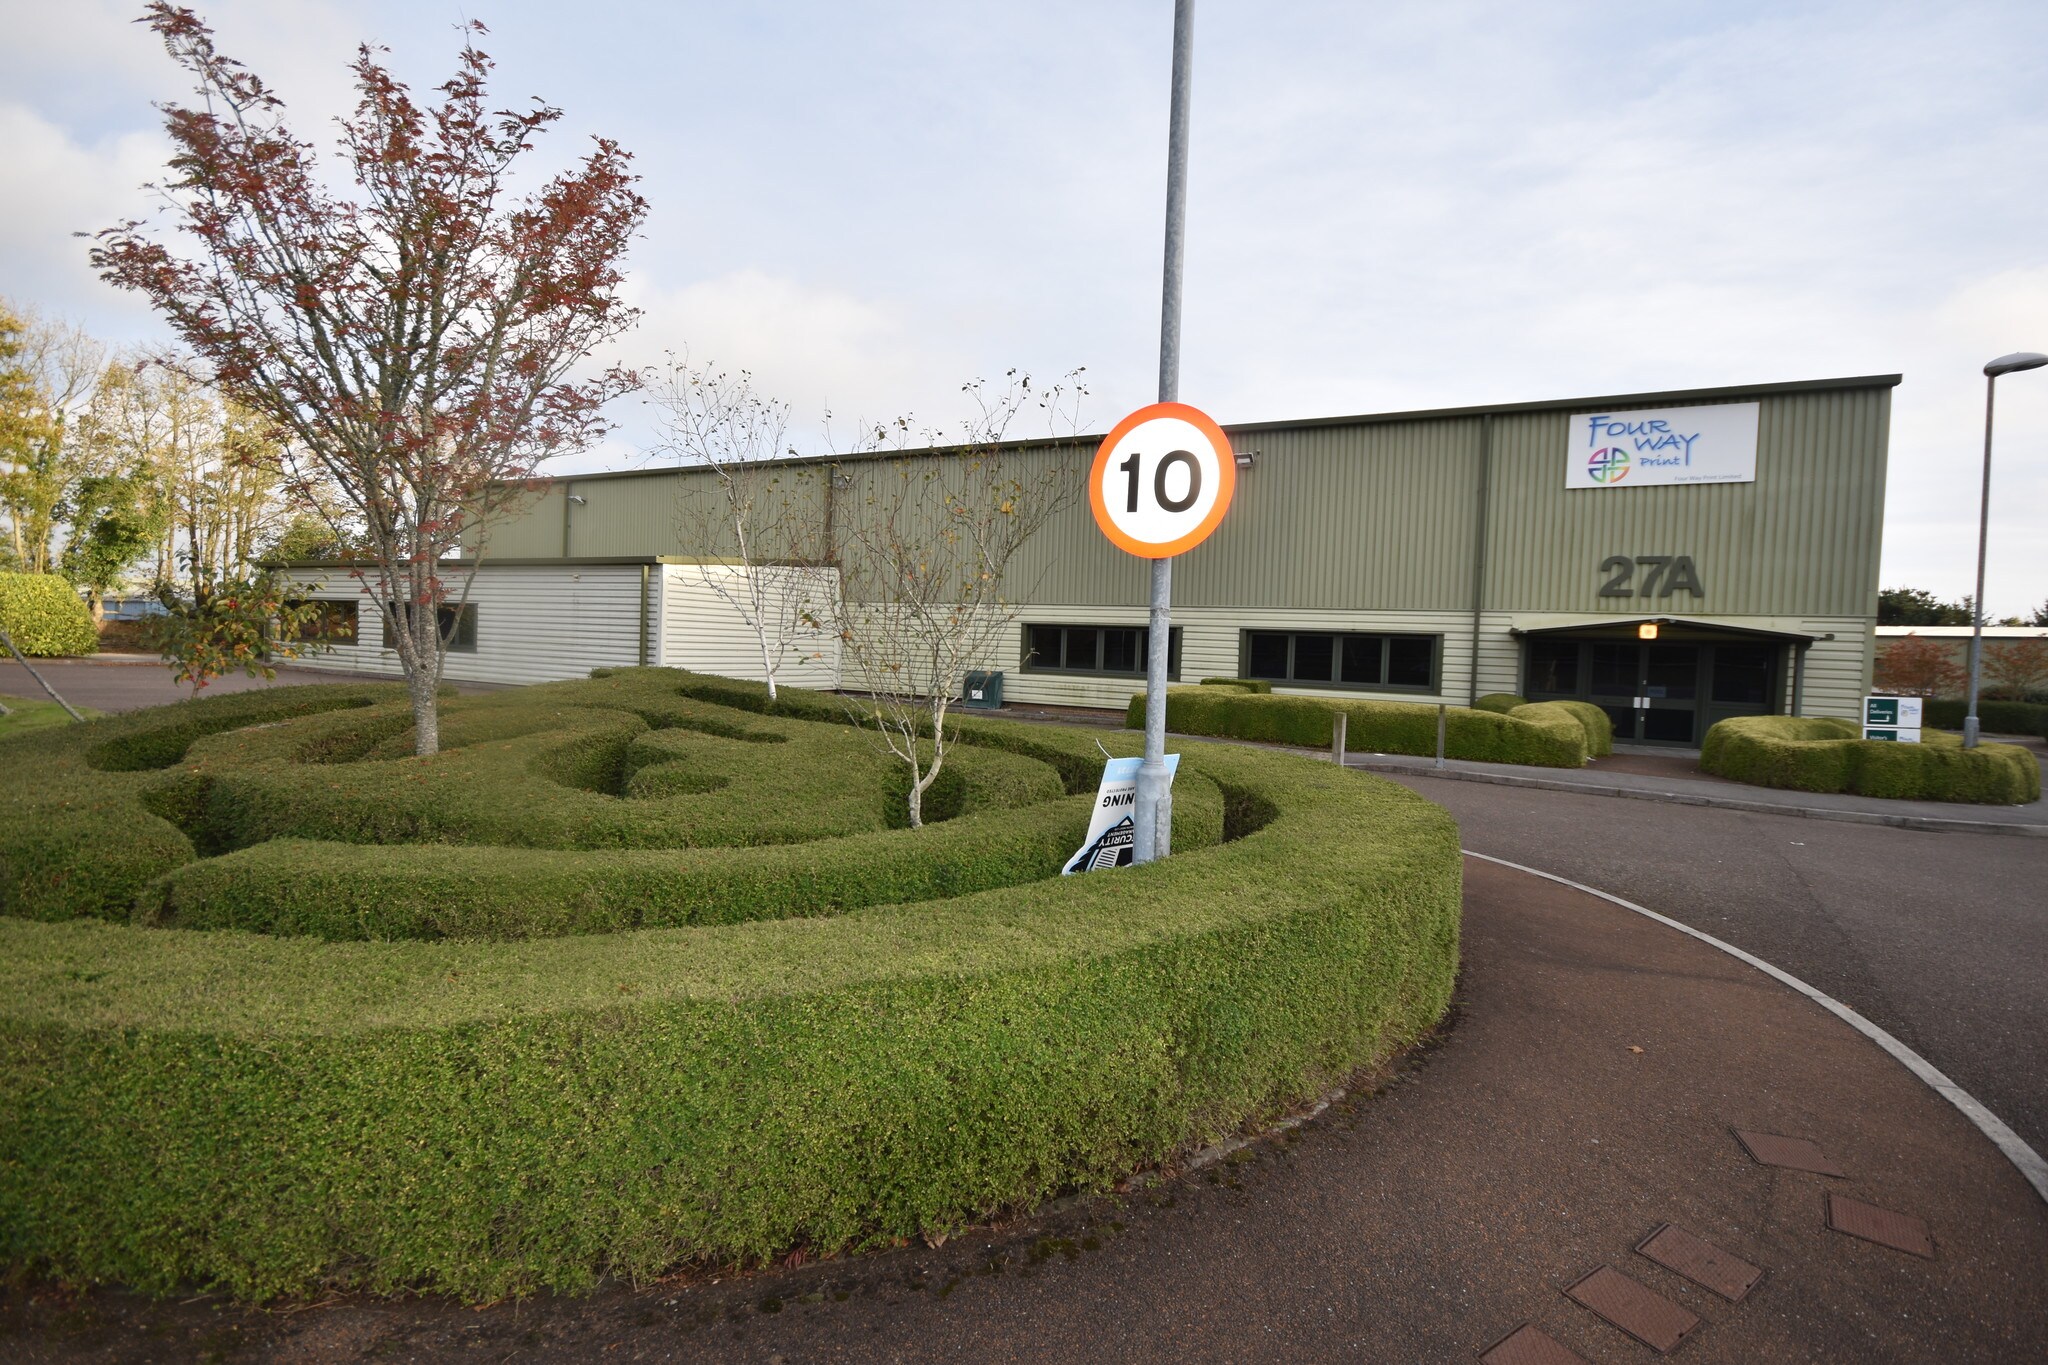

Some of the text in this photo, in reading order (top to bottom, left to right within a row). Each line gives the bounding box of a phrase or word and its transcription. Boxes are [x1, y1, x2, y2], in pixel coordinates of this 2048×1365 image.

[1634, 433, 1700, 466] WAY
[1640, 454, 1680, 466] Print
[1120, 449, 1202, 513] 10
[1599, 555, 1705, 598] 27A
[1102, 793, 1135, 808] NING
[1098, 834, 1133, 847] CURITY
